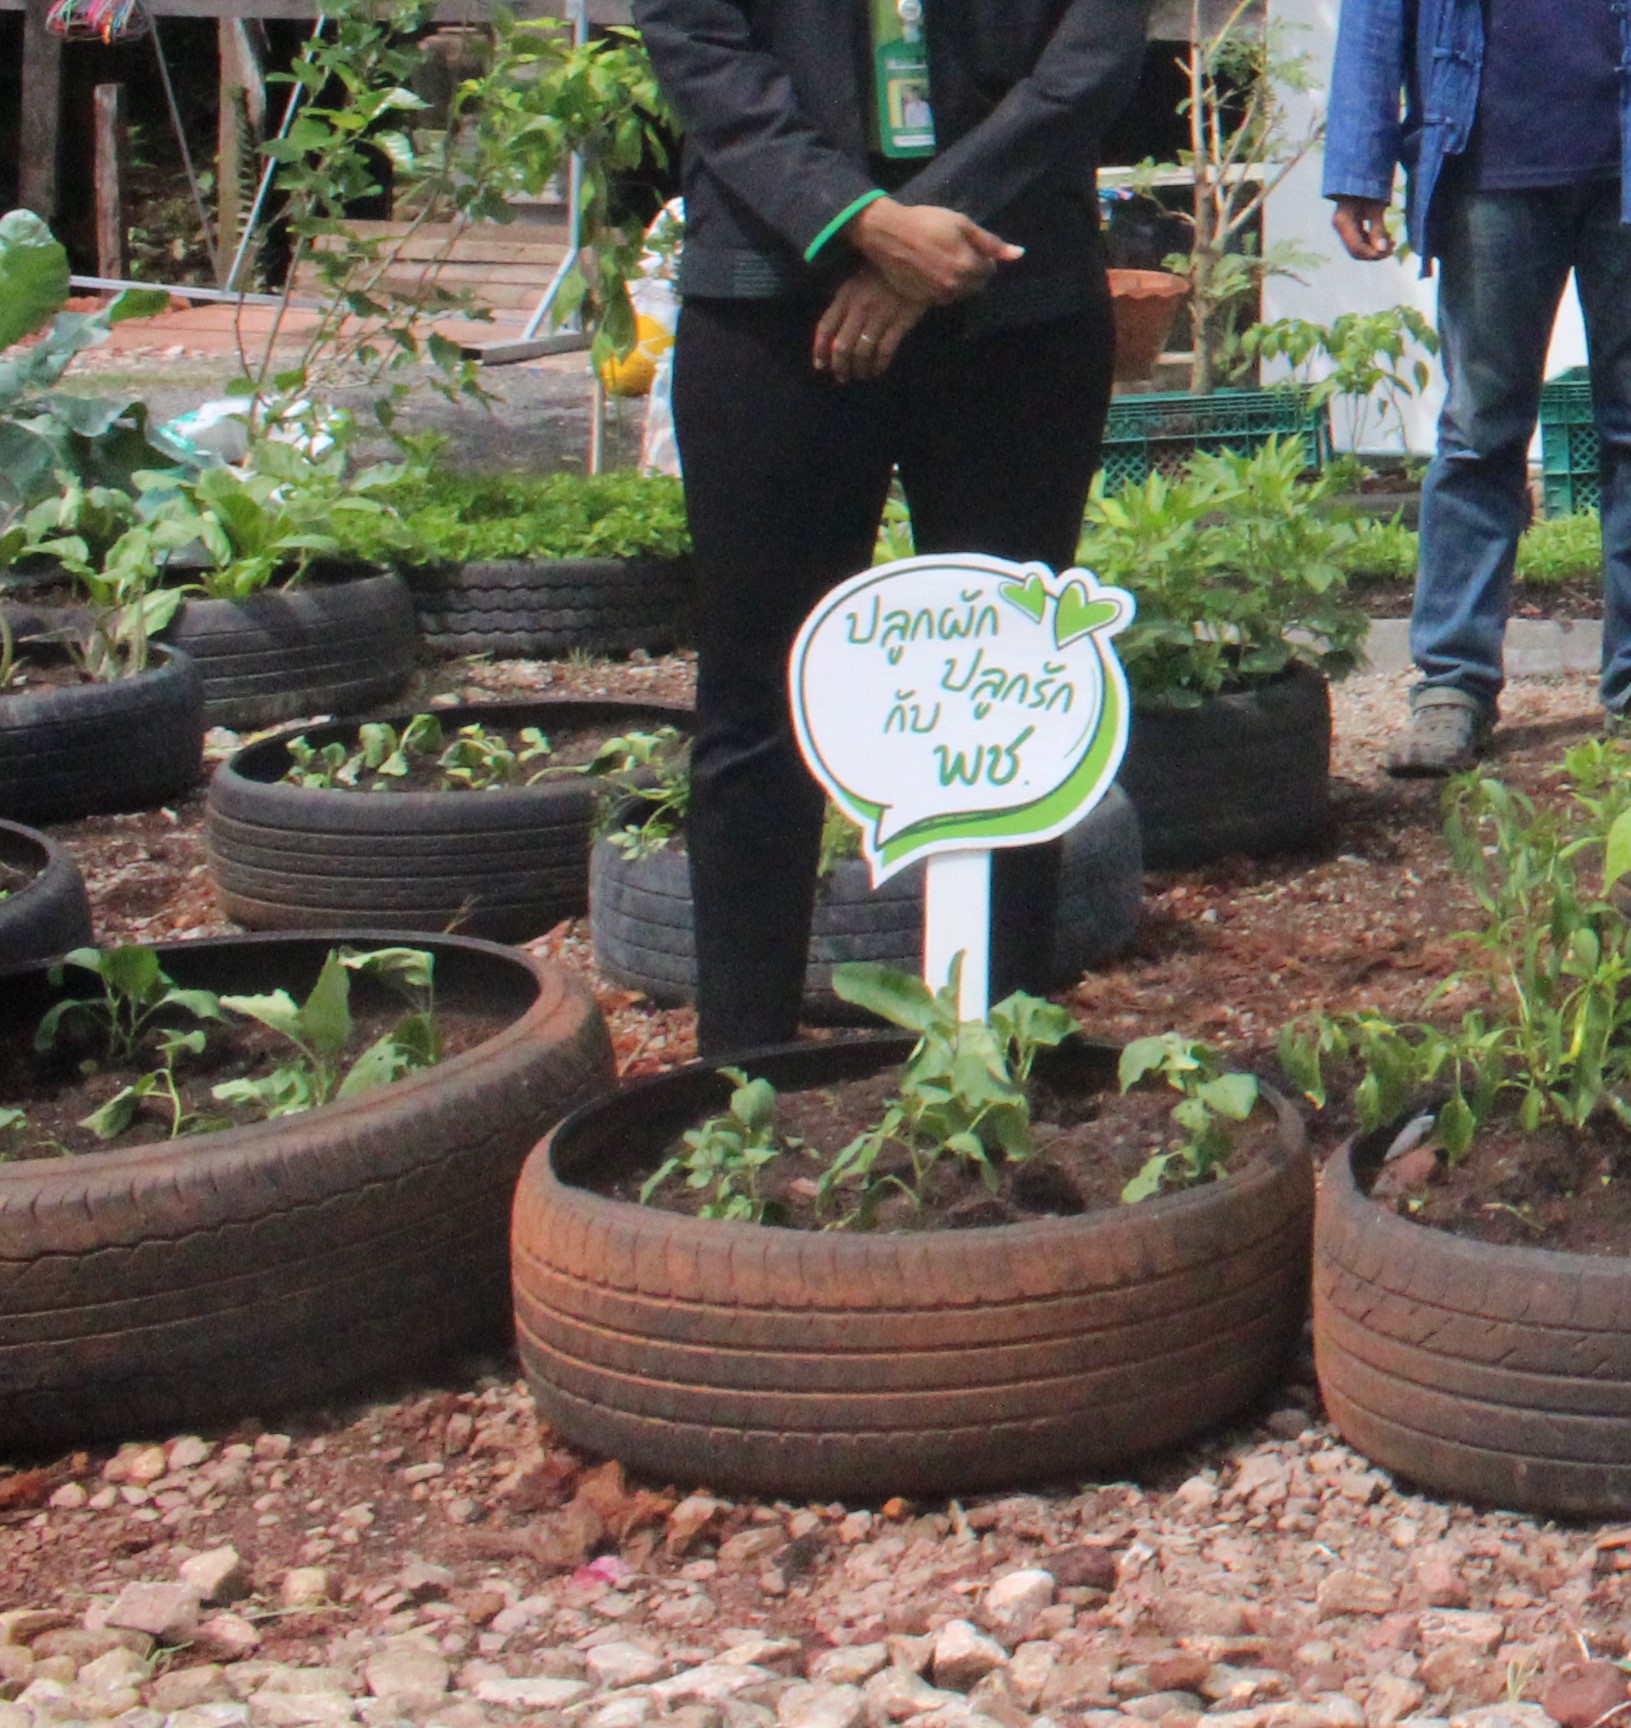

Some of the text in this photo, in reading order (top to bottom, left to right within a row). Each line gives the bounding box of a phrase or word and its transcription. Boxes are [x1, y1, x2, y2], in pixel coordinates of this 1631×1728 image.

[845, 588, 1000, 665] ปลูกผัก
[883, 688, 942, 734] กับ
[940, 647, 1075, 721] ปลูกรัก
